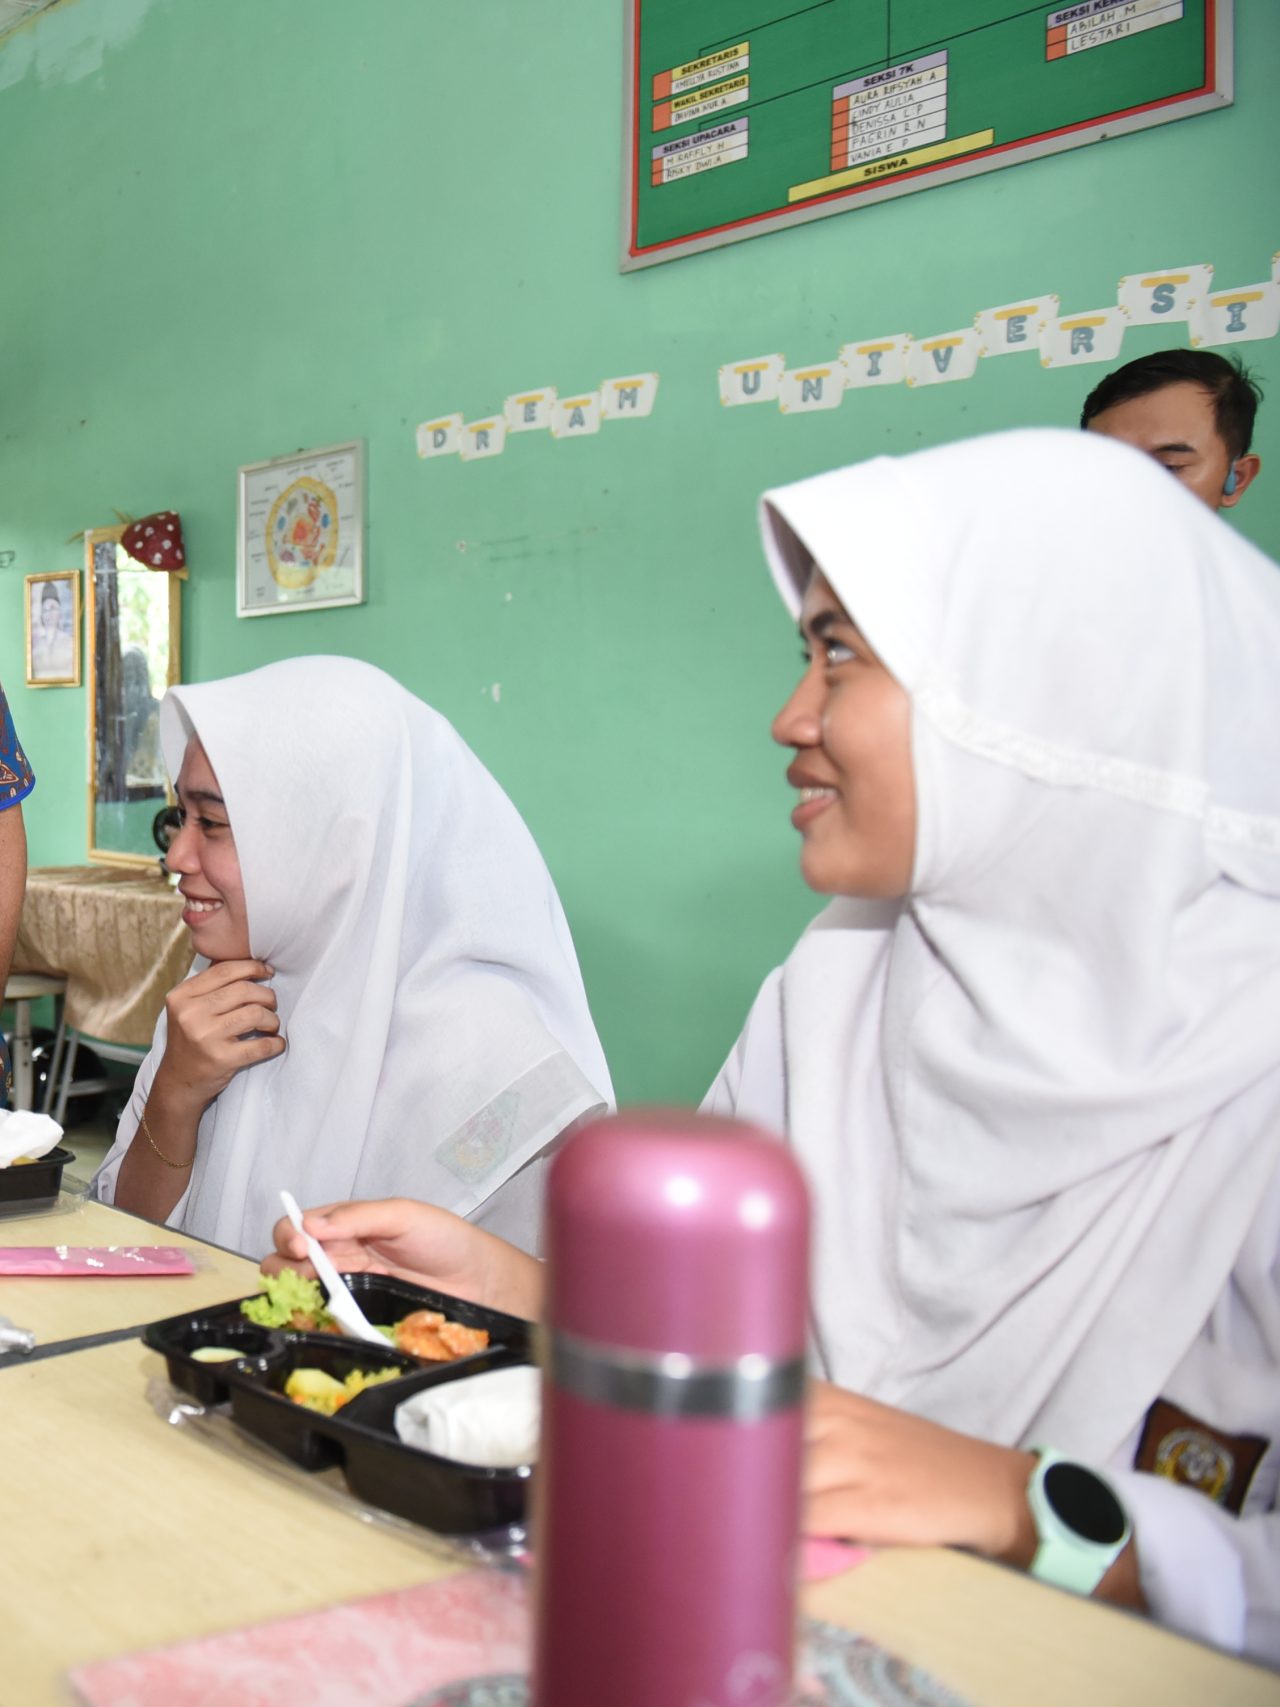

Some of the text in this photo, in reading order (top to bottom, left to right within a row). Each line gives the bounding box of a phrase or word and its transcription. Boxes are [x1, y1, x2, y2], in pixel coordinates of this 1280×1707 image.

[1055, 4, 1090, 23] SEKSI
[1071, 22, 1130, 51] LESTARI
[681, 47, 739, 75] SEKRETARIS
[863, 64, 914, 88] SEKSI 7K
[674, 77, 746, 109] WAKIL SEKRETARIS
[663, 124, 736, 154] SEKSI UPACARA
[864, 158, 908, 176] SISWA
[433, 387, 638, 450] DREAM
